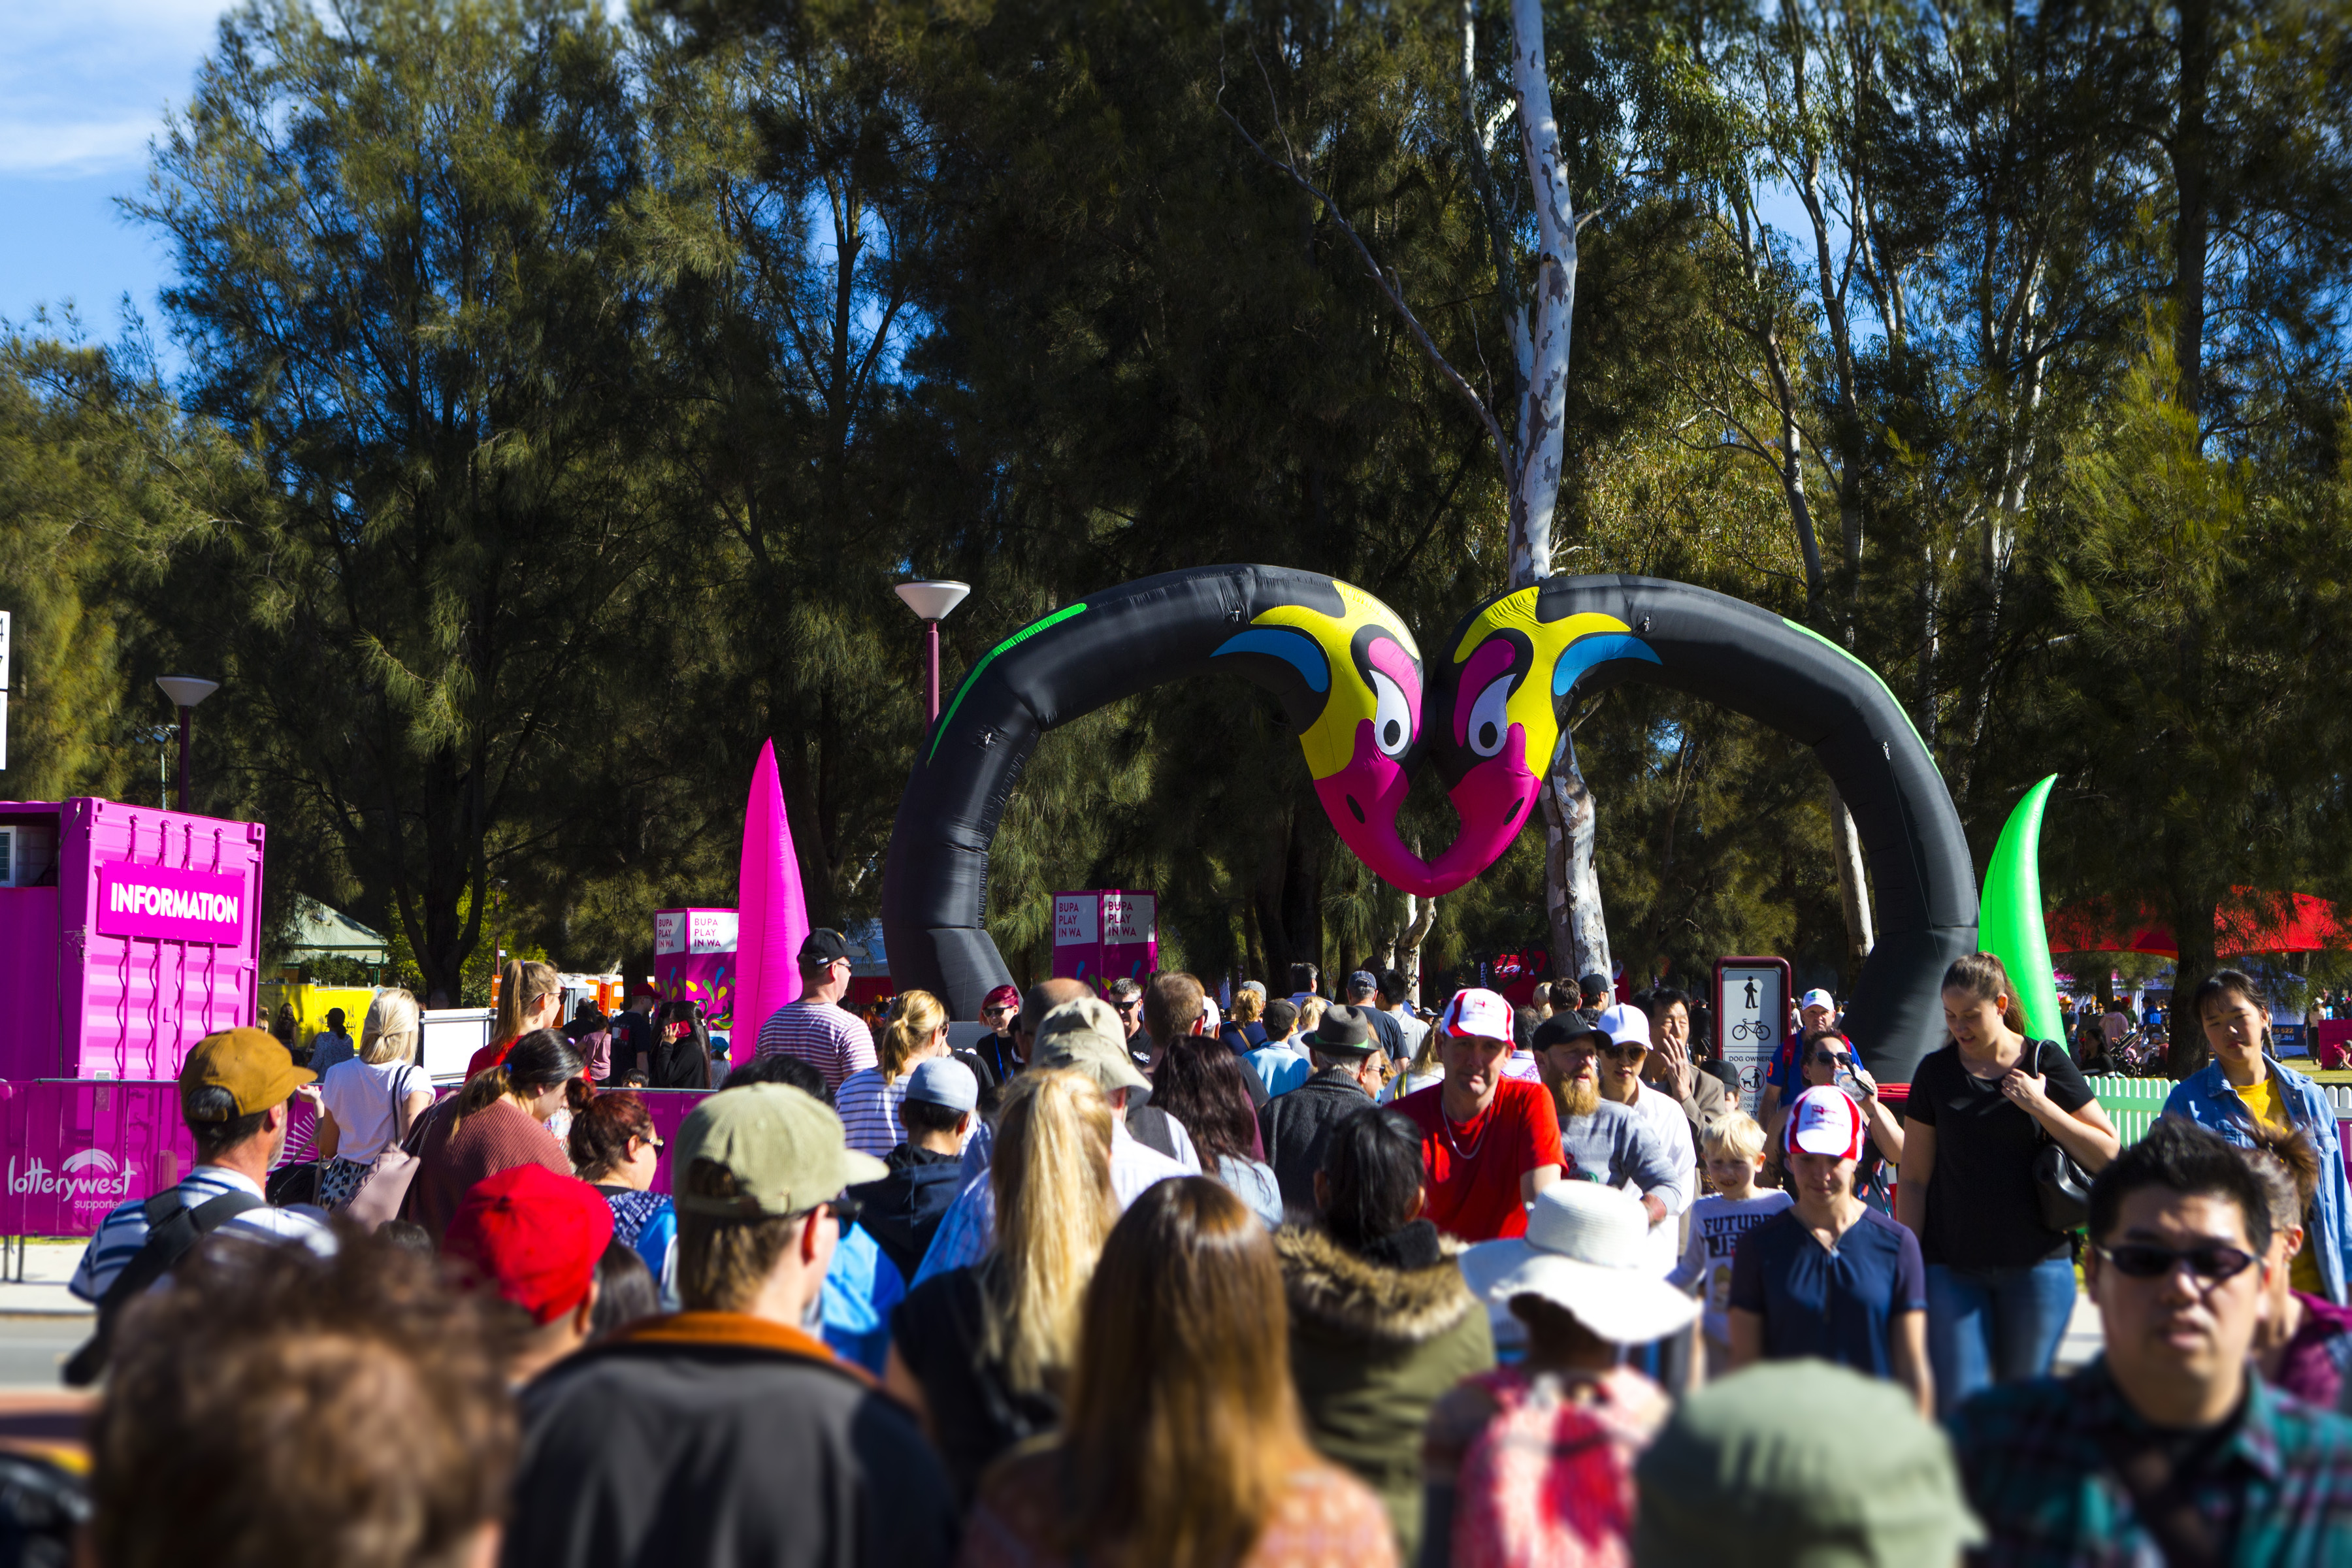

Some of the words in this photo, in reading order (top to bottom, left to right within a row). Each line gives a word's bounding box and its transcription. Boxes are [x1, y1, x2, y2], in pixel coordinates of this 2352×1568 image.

[110, 882, 238, 924] INFORMATION
[1058, 902, 1079, 912] BUPA
[1108, 901, 1134, 911] BUPA
[659, 919, 673, 927] BUPA
[1058, 915, 1077, 925] PLAY
[1108, 913, 1132, 924] PLAY
[658, 929, 672, 938] PLAY
[694, 928, 717, 937] PLAY
[1058, 928, 1067, 938] IN
[1068, 927, 1082, 938] WA
[1108, 926, 1119, 937] IN
[1121, 926, 1137, 936] WA
[658, 939, 664, 948] IN
[665, 939, 674, 947] WA
[694, 939, 704, 947] IN
[706, 939, 721, 947] WA
[8, 1154, 138, 1202] lotterywest
